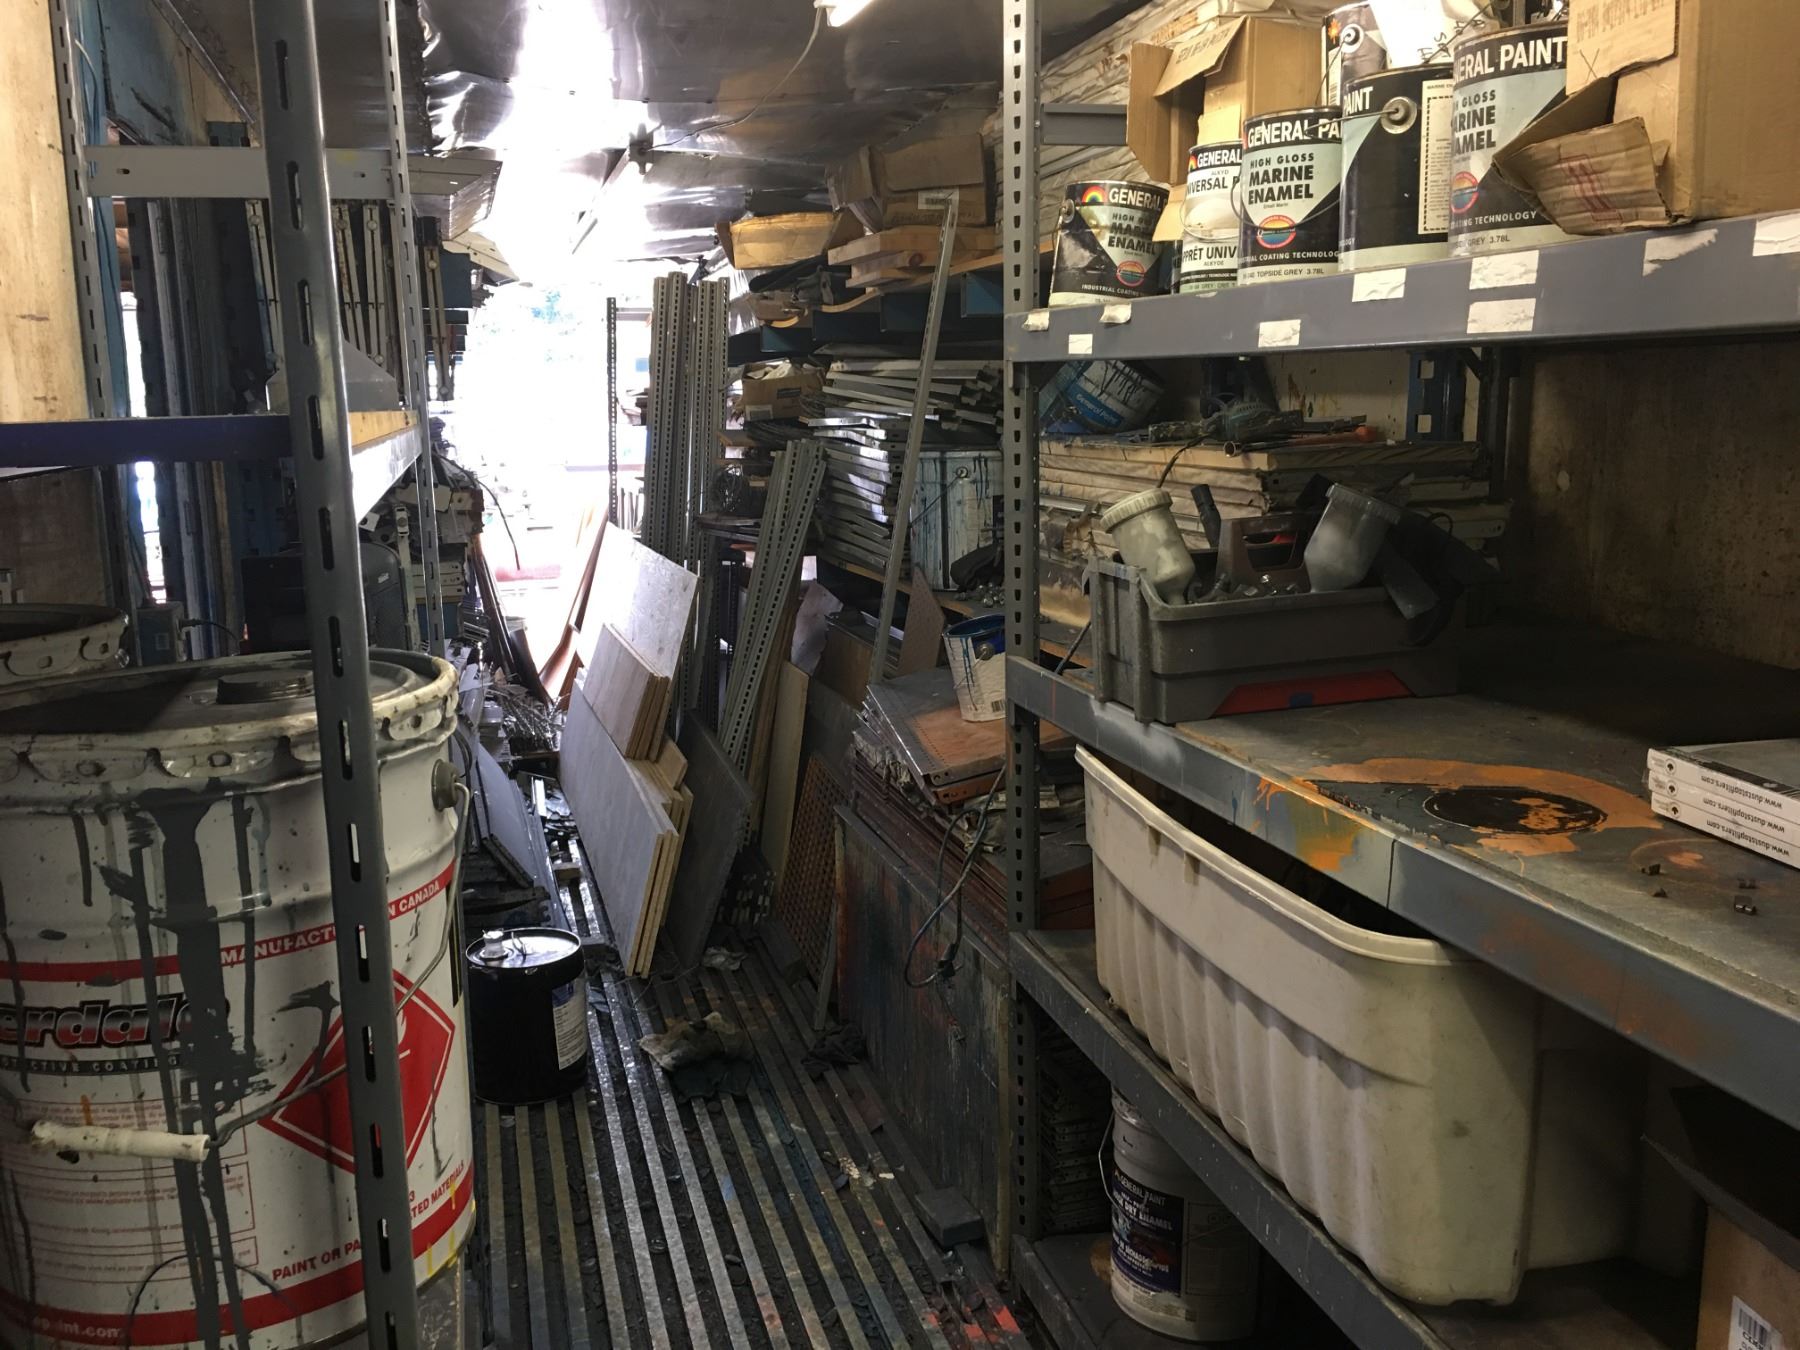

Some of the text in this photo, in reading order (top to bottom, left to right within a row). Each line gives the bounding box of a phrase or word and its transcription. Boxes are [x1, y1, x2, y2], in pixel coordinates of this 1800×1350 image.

[1500, 35, 1569, 71] PAINT
[1461, 88, 1497, 109] GLOSS
[1246, 119, 1314, 149] GENERAL
[1197, 149, 1242, 168] GENERAL
[1250, 152, 1315, 169] HIGH GLOSS
[1248, 164, 1315, 187] MARINE
[1108, 187, 1161, 210] GENERAL
[1248, 183, 1314, 205] ENAMEL
[1112, 212, 1135, 223] HIGH
[1475, 210, 1537, 225] TECHNOLOGY
[1206, 245, 1237, 260] UNIV
[1259, 251, 1290, 262] COATING
[1257, 269, 1283, 278] TOPSIDE
[1284, 267, 1303, 276] GREY
[1081, 283, 1116, 293] INDUSTRIAL
[1703, 796, 1785, 833] www.duststopfilters.com
[1706, 818, 1790, 856] www.duststopfilters.com
[399, 880, 440, 912] CANADA
[272, 1256, 318, 1281] PAINT
[320, 1247, 342, 1265] OR
[431, 1160, 465, 1203] MATERIALS
